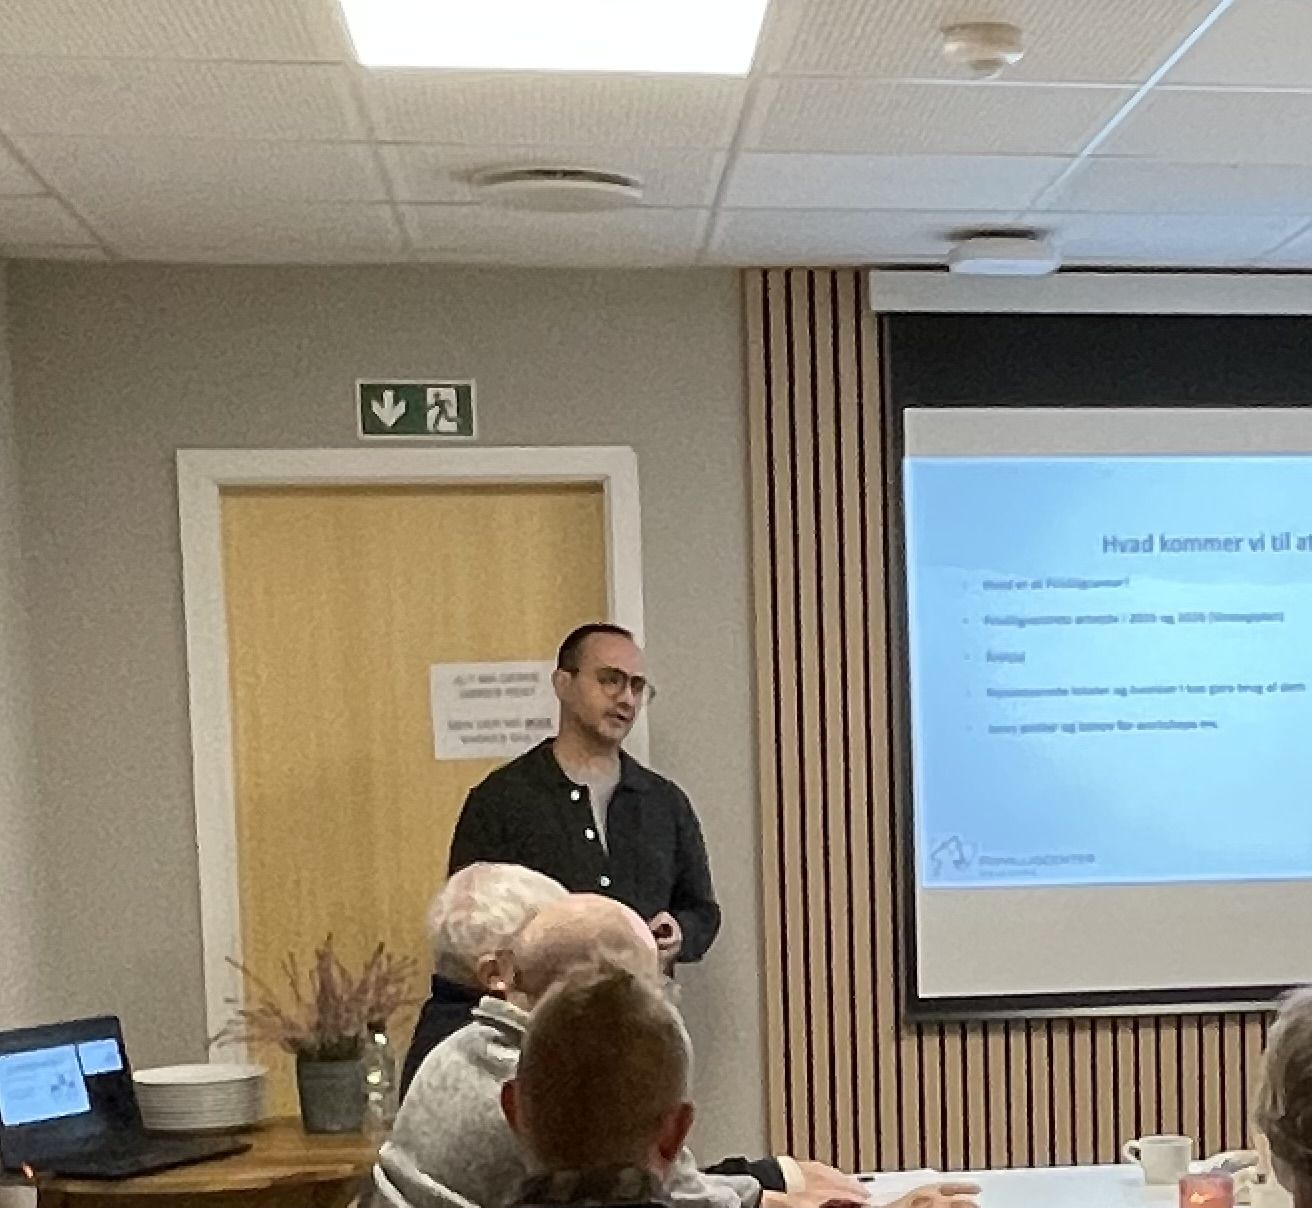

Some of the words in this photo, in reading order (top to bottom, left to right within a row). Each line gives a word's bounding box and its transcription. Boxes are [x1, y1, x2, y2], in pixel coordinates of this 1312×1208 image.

[1102, 533, 1154, 554] Hvad
[1159, 531, 1243, 553] kommer
[1248, 532, 1266, 553] vi
[1270, 530, 1292, 553] til
